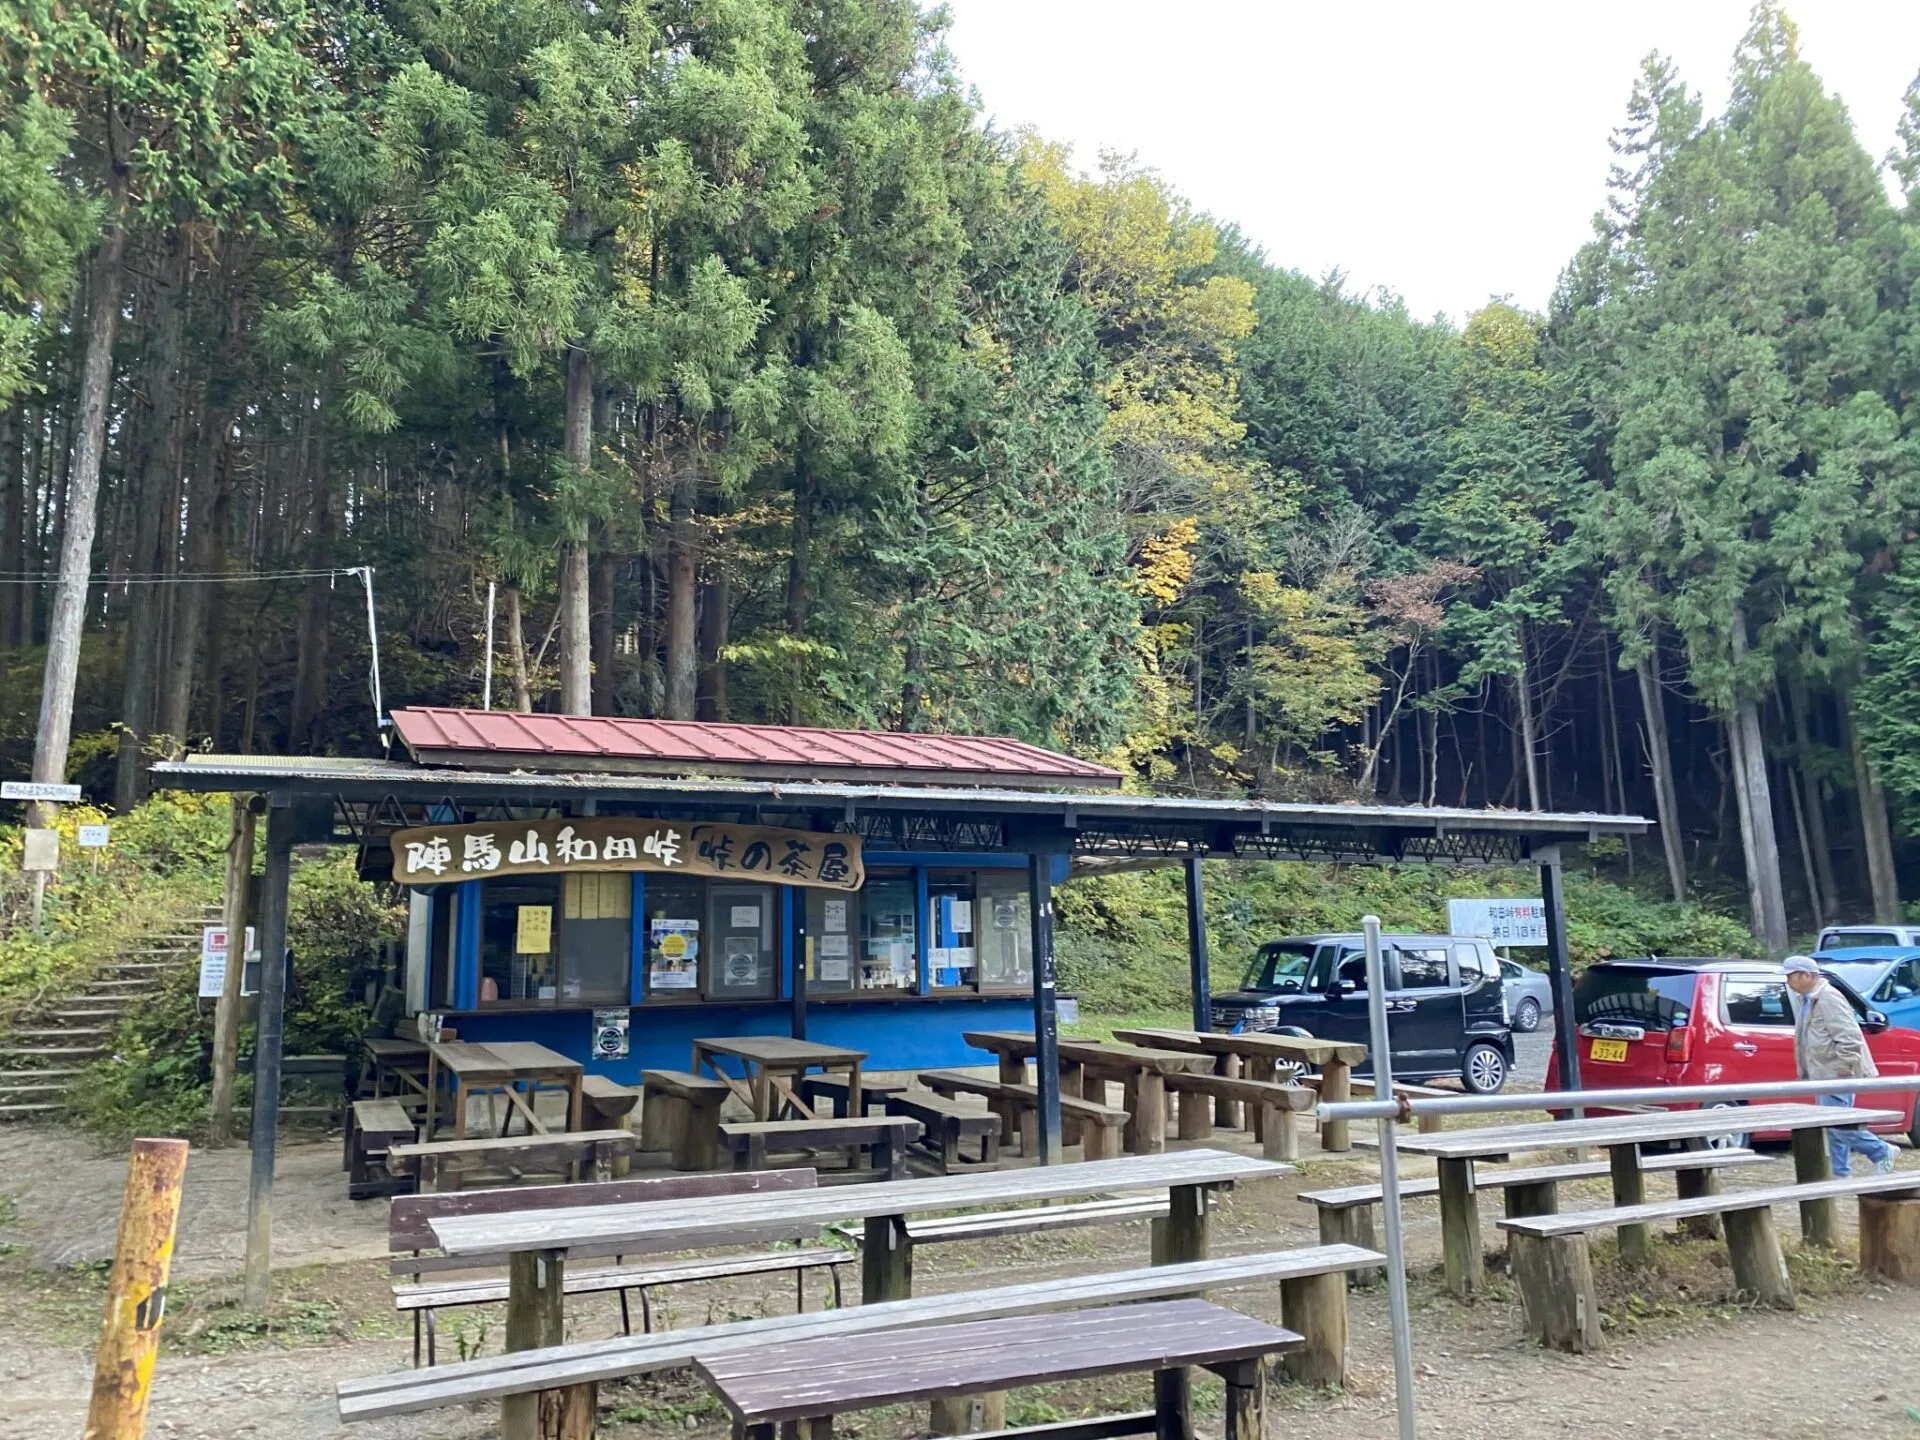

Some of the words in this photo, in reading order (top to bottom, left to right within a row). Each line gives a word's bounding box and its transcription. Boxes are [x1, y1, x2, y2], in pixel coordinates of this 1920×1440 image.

[404, 825, 684, 876] 陣馬山和田峠
